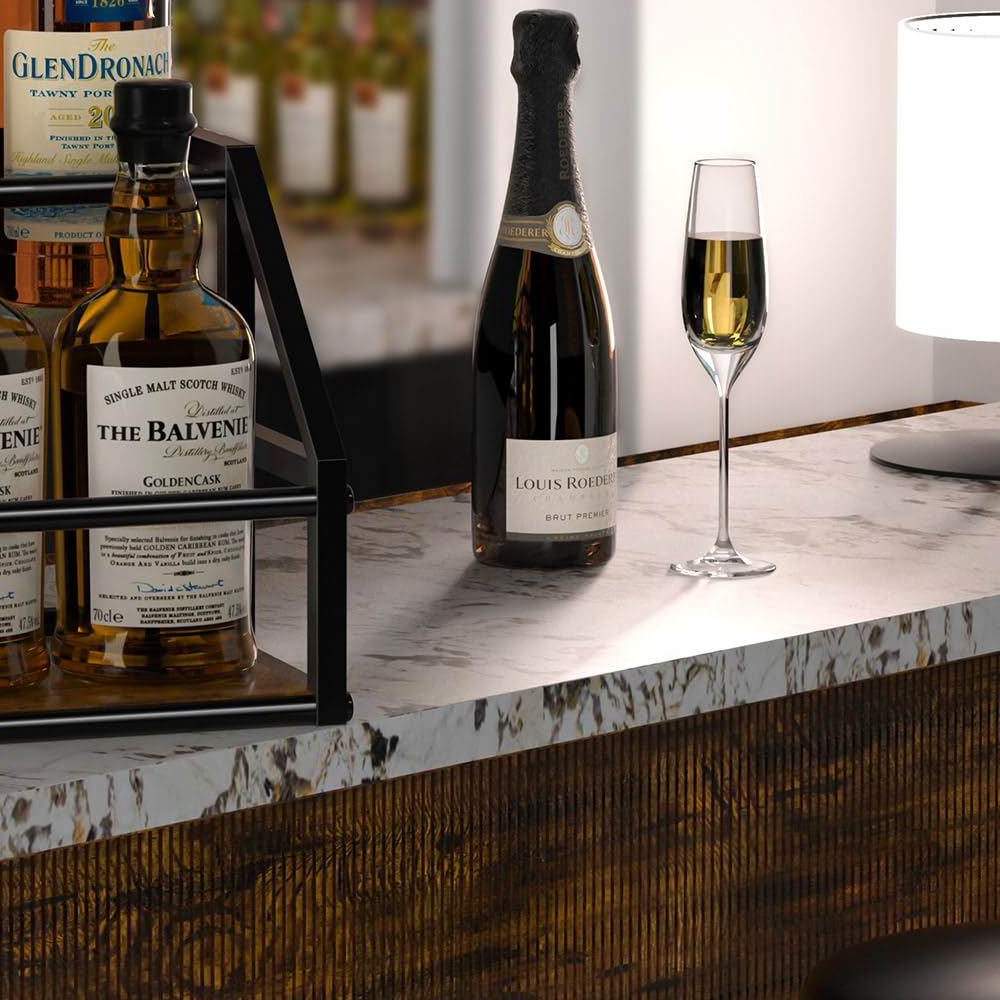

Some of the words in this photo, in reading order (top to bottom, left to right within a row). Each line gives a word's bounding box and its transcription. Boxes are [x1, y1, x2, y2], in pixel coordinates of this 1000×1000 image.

[88, 38, 117, 52] The
[30, 89, 77, 98] TAWNY
[54, 231, 94, 239] PRODUCT
[104, 385, 143, 405] SINGLE
[147, 380, 177, 393] MALT
[180, 379, 218, 390] SCOTCH
[221, 381, 246, 400] WHISKY
[11, 392, 37, 410] WHISKY
[184, 400, 229, 418] Distilled
[97, 424, 141, 441] THE
[515, 476, 562, 490] LOUIS
[177, 541, 217, 550] CARIBBEAN
